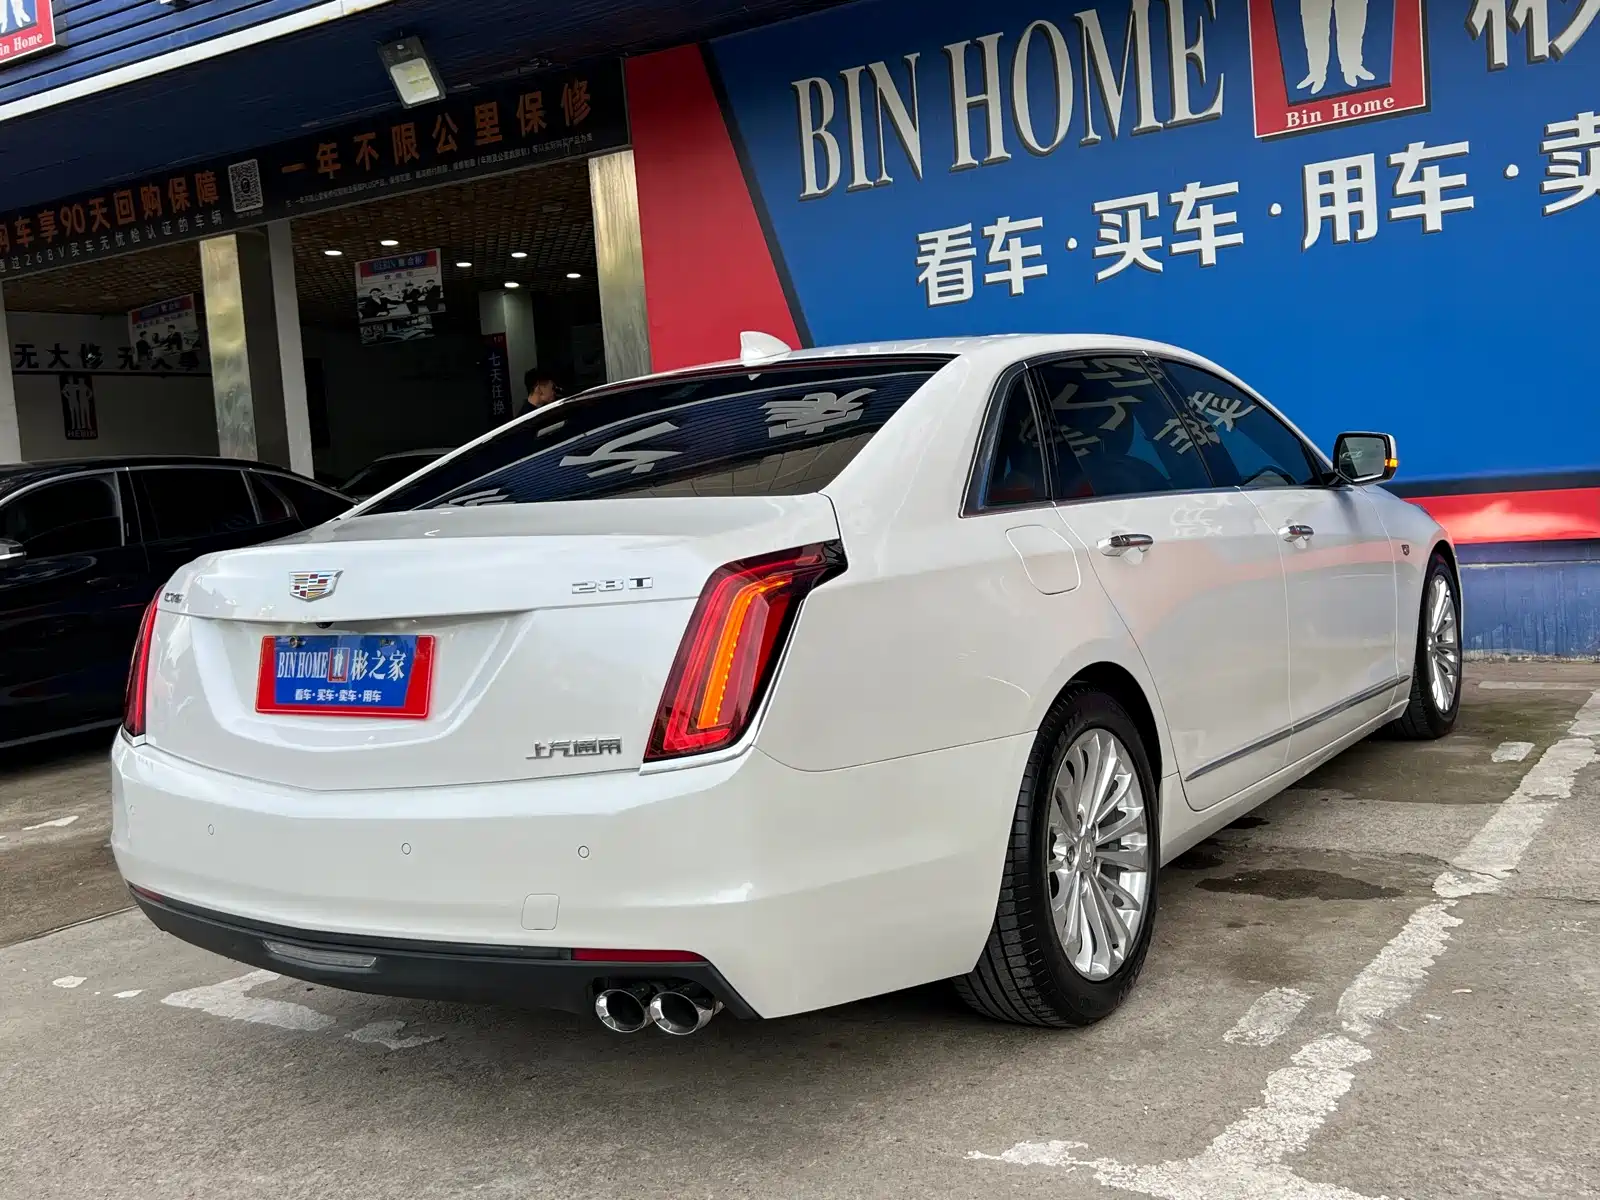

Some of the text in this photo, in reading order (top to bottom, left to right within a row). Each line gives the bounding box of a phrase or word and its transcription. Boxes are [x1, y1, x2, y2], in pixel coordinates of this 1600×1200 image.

[13, 33, 43, 51] Home
[791, 0, 1225, 201] BIN HOME
[1286, 96, 1396, 129] Bin Home
[281, 79, 592, 180] 一年不限公里保修
[276, 650, 407, 682] BIN HOME 彬之家
[526, 737, 622, 760] 上汽通用
